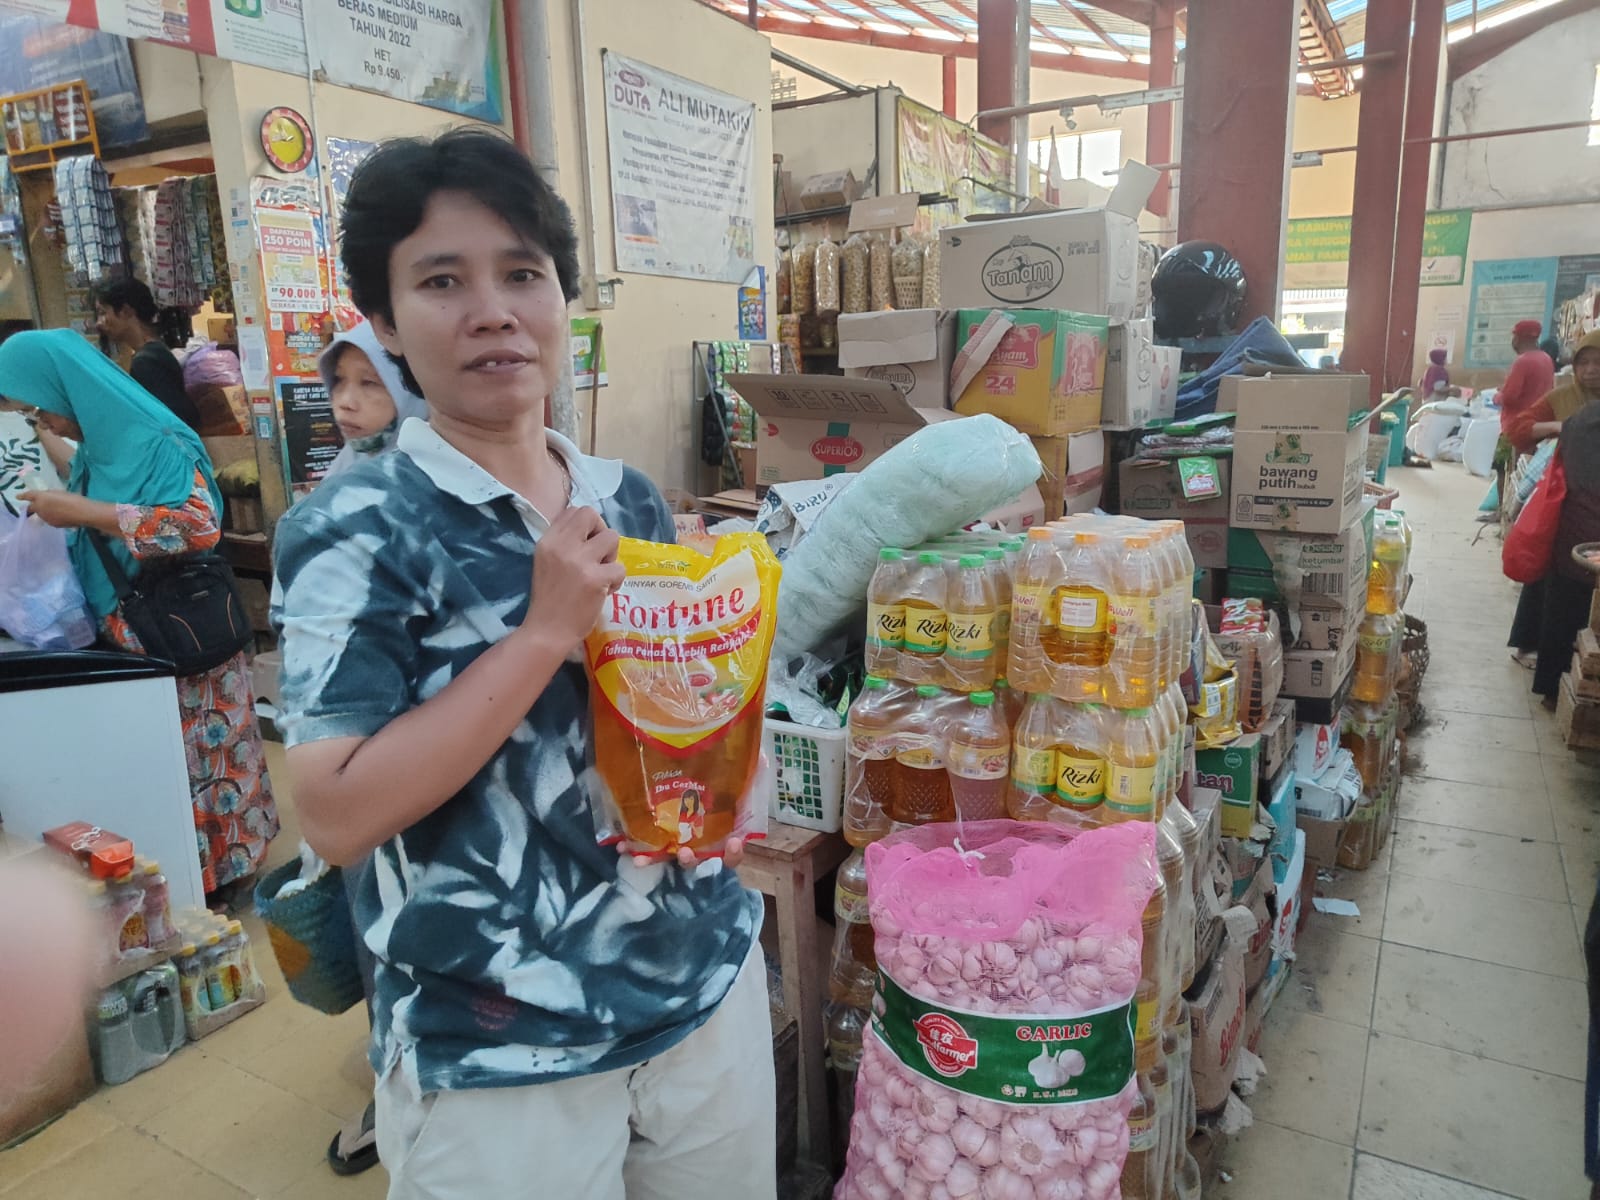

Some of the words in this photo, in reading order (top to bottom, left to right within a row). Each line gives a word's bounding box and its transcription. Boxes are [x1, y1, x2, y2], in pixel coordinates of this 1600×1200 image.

[338, 0, 375, 17] BERAS
[377, 6, 418, 31] MEDIUM
[428, 6, 463, 29] HARGA
[350, 17, 386, 41] TAHUN
[388, 29, 411, 48] 2022
[374, 48, 391, 62] HET
[364, 61, 376, 77] Rp
[614, 84, 651, 111] DUTA
[658, 87, 683, 114] ALI
[264, 235, 284, 246] 250
[286, 237, 311, 248] POIN
[987, 260, 1054, 287] Tanam
[280, 287, 316, 299] 90.000
[985, 375, 1015, 389] 24
[815, 442, 859, 458] SUPERIOR
[1260, 466, 1318, 481] bawang
[1259, 478, 1296, 490] putih
[792, 490, 828, 513] BIRU
[624, 580, 657, 589] MINYAK
[658, 580, 694, 591] GORENG
[696, 574, 718, 593] SAWIT
[610, 587, 745, 630] Fortune
[947, 621, 982, 643] Rizki
[605, 643, 634, 656] Tahan
[636, 645, 665, 657] Panas
[679, 646, 707, 658] Lebih
[1061, 766, 1102, 788] Rizki
[1016, 1022, 1092, 1042] GARLIC
